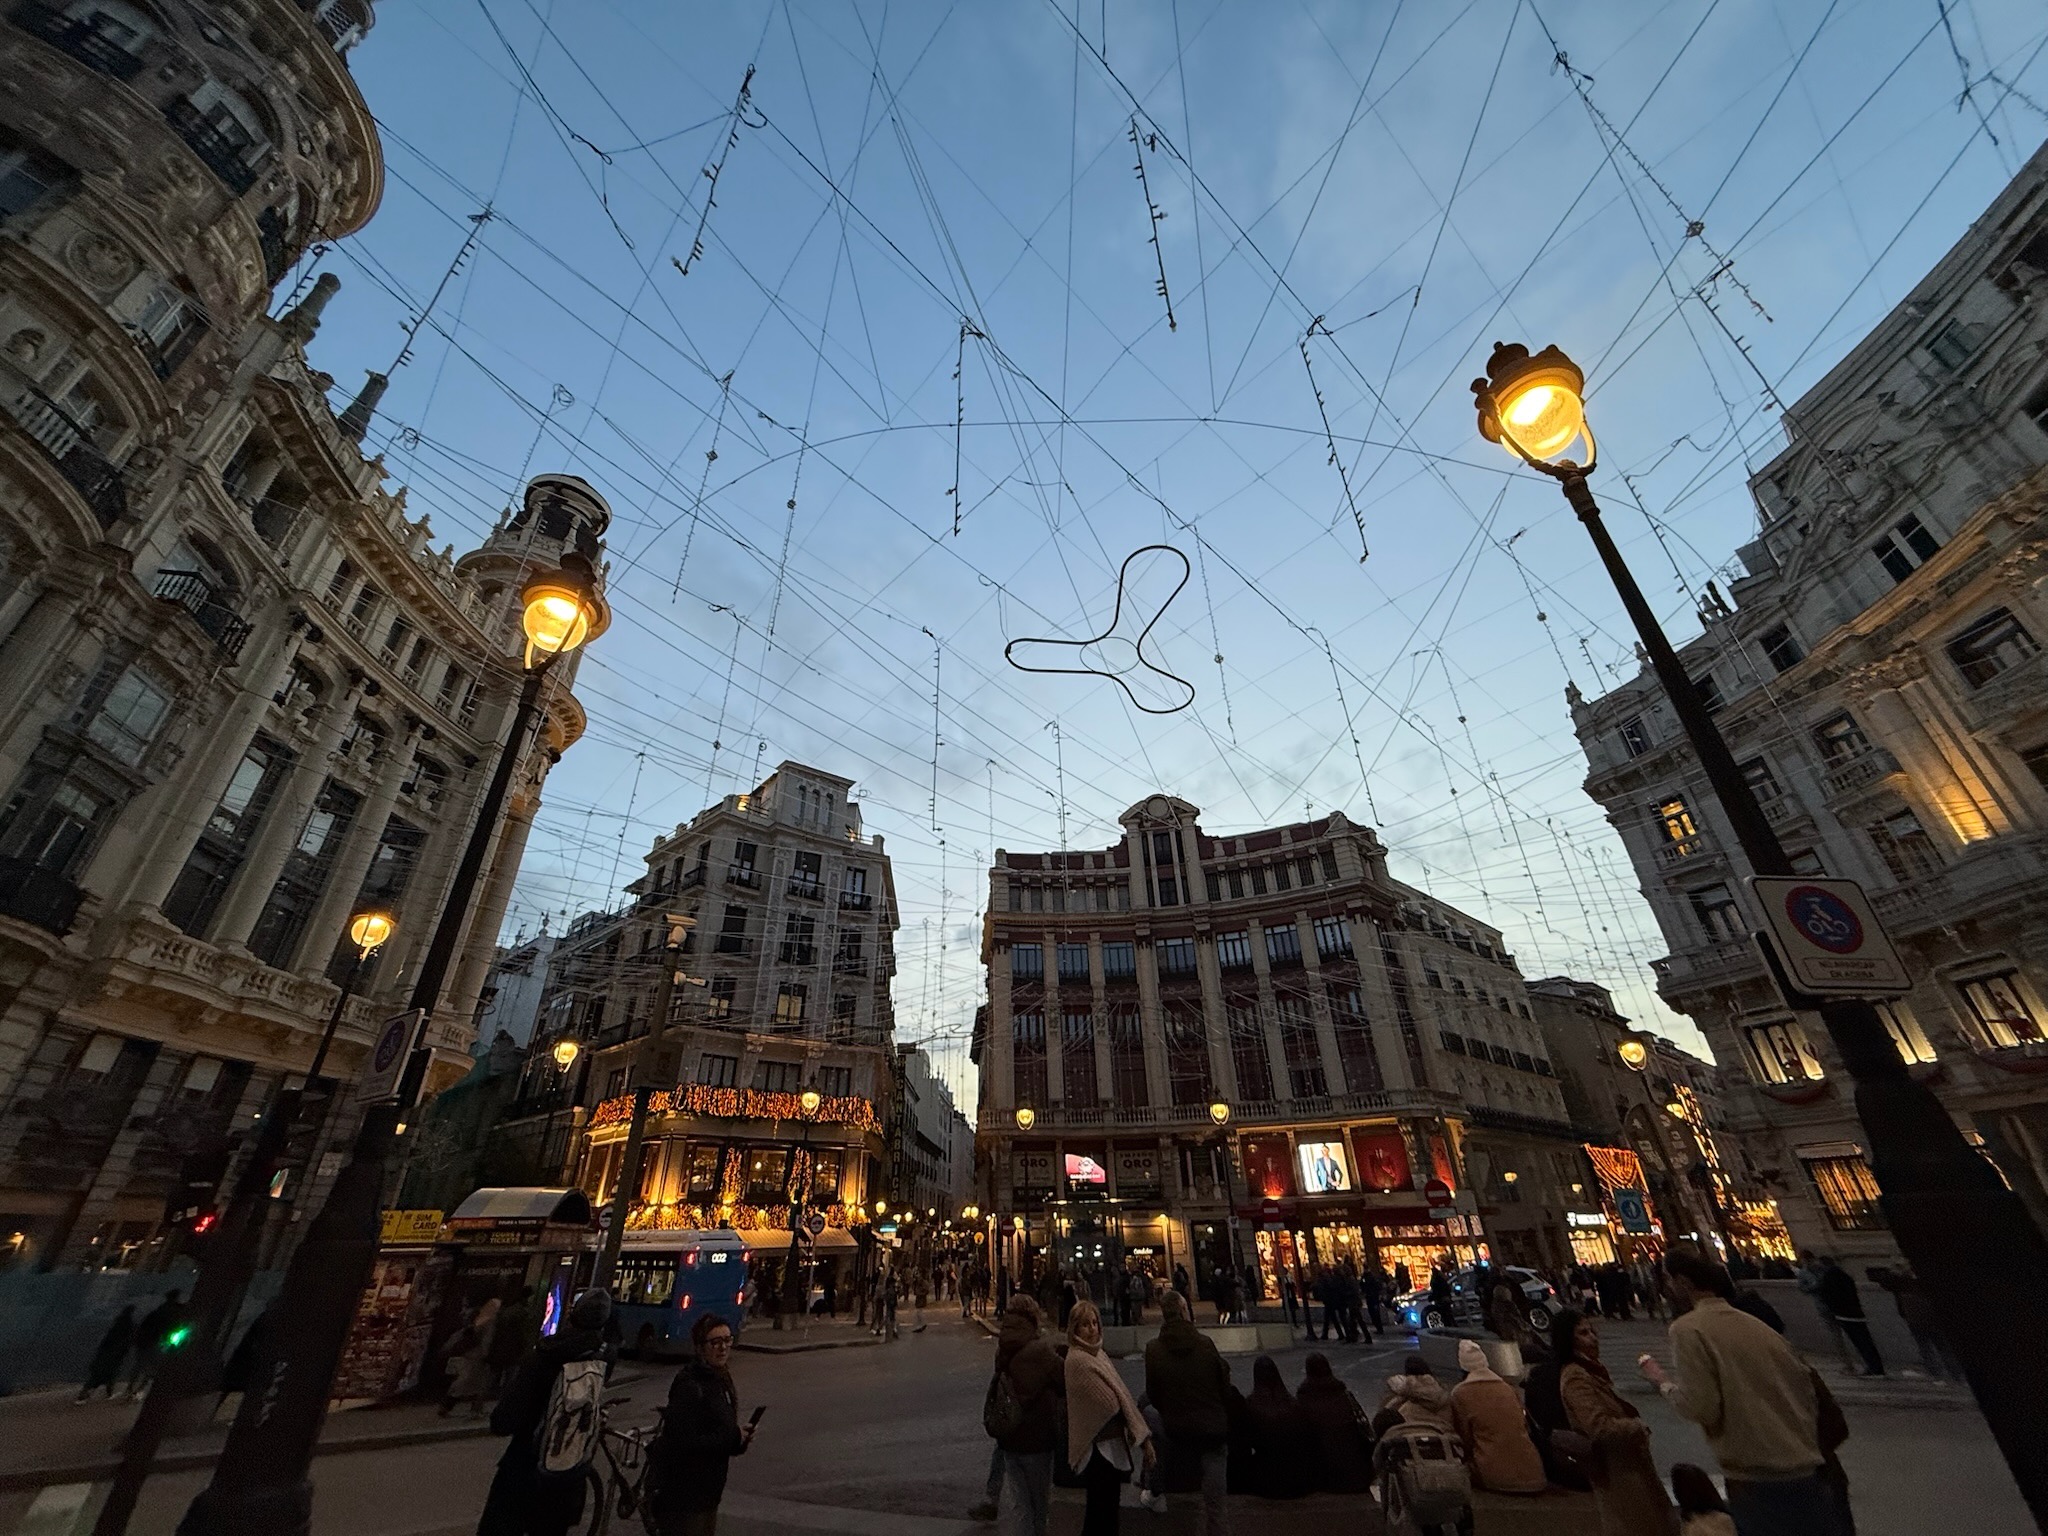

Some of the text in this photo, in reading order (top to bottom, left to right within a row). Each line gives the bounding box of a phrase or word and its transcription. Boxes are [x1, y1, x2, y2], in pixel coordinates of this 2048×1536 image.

[1020, 1158, 1048, 1167] ORO
[1123, 1158, 1152, 1169] ORO
[415, 1213, 432, 1221] SIM
[412, 1221, 437, 1230] CARD
[711, 1252, 728, 1264] 002
